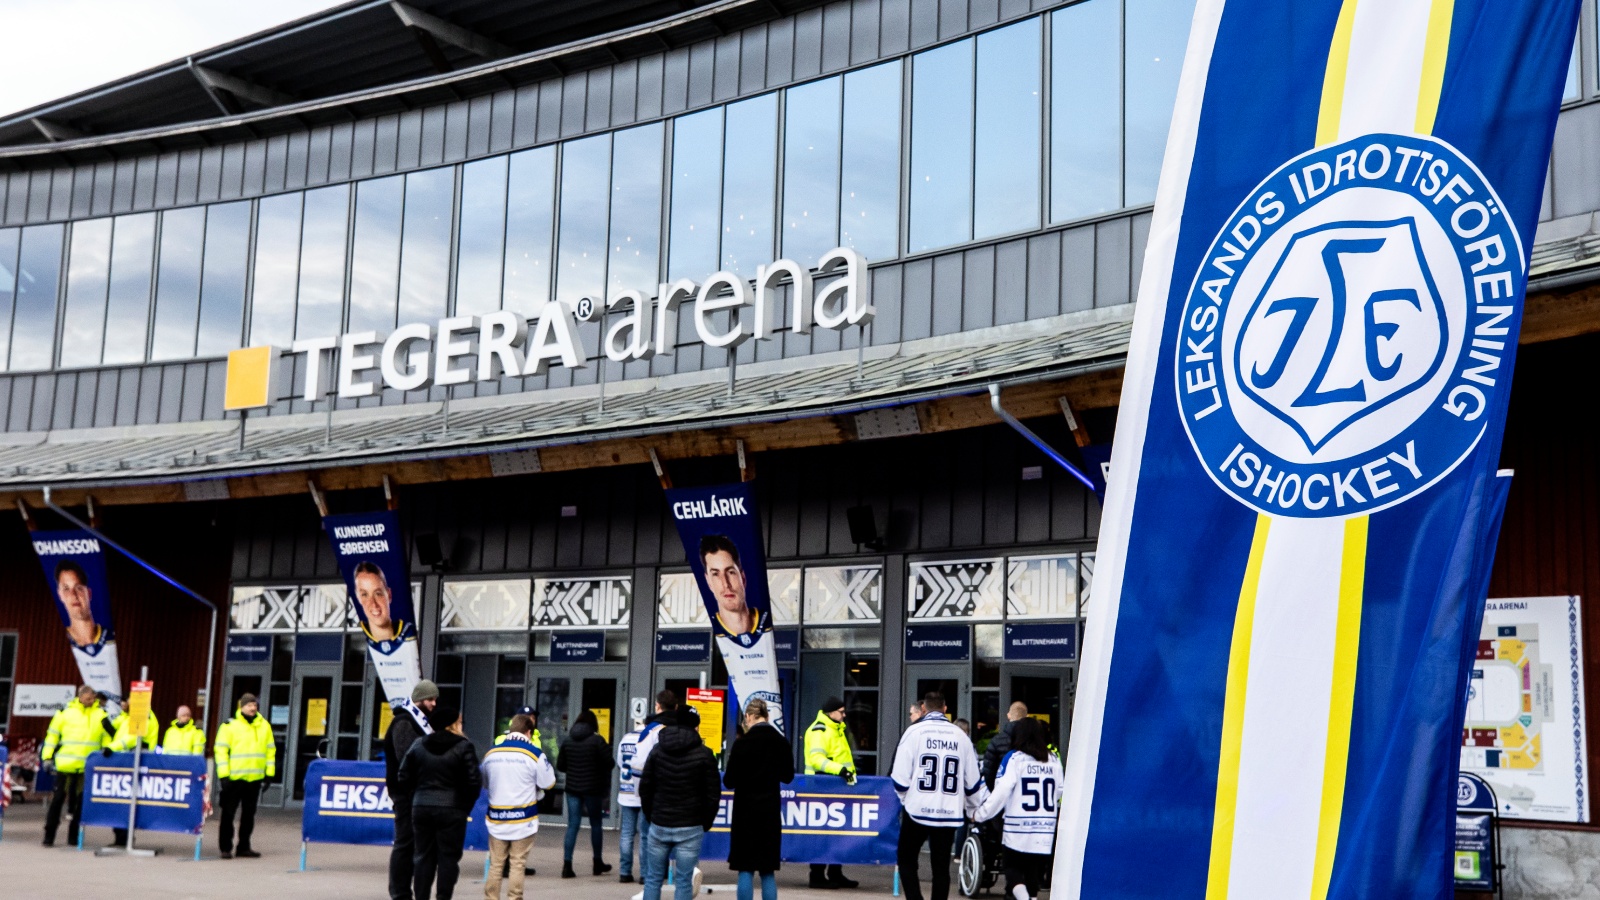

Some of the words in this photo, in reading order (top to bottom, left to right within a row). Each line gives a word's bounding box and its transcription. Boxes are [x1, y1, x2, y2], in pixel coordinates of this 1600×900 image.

[1185, 190, 1286, 421] LEKSANDS
[1287, 142, 1515, 423] IDROTTSFÖRENING
[604, 246, 876, 362] arena
[1219, 440, 1424, 511] ISHOCKEY
[673, 495, 748, 520] CEHLÁRIK
[334, 523, 385, 539] KUNNERUP
[339, 539, 389, 556] SØRENSEN
[635, 702, 642, 715] 4
[926, 737, 959, 751] ÖSTMAN
[916, 753, 960, 797] 38
[1027, 763, 1053, 775] ÖSTMAN
[91, 773, 174, 800] LEKSNDS
[174, 778, 191, 801] IF
[319, 783, 395, 811] LEKSA
[1021, 777, 1056, 812] 50
[851, 803, 879, 828] IF
